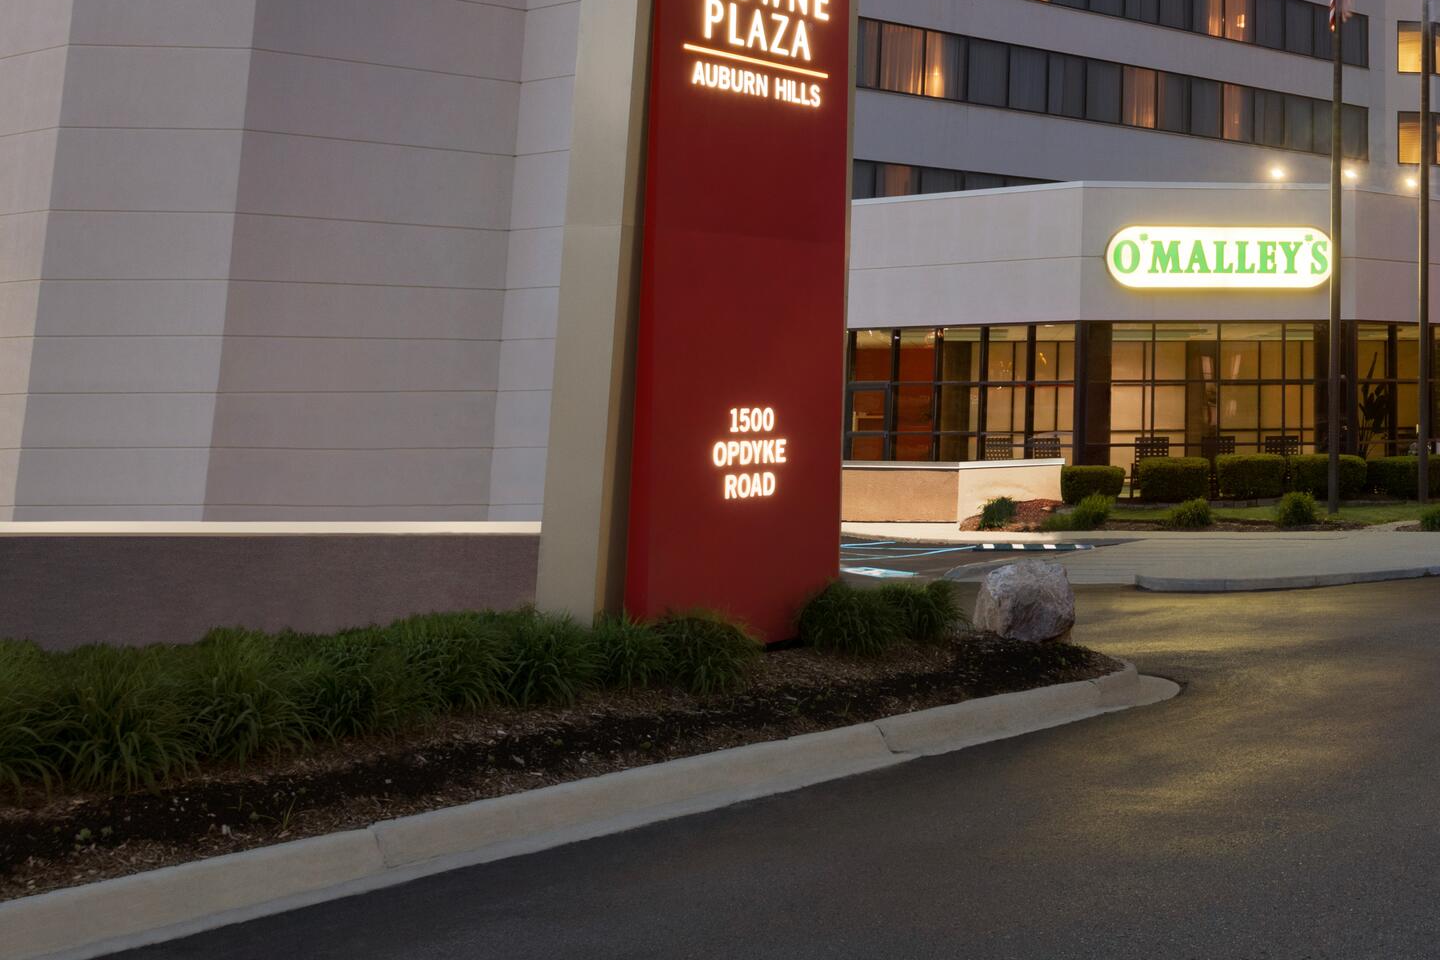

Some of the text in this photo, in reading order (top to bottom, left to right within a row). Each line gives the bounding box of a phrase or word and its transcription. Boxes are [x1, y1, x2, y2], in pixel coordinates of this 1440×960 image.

[692, 61, 821, 107] AUBURN HILLS
[1113, 233, 1329, 275] O'MALLEY'S
[729, 407, 774, 433] 1500
[712, 439, 787, 466] OPDYKE
[724, 472, 776, 500] ROAD
